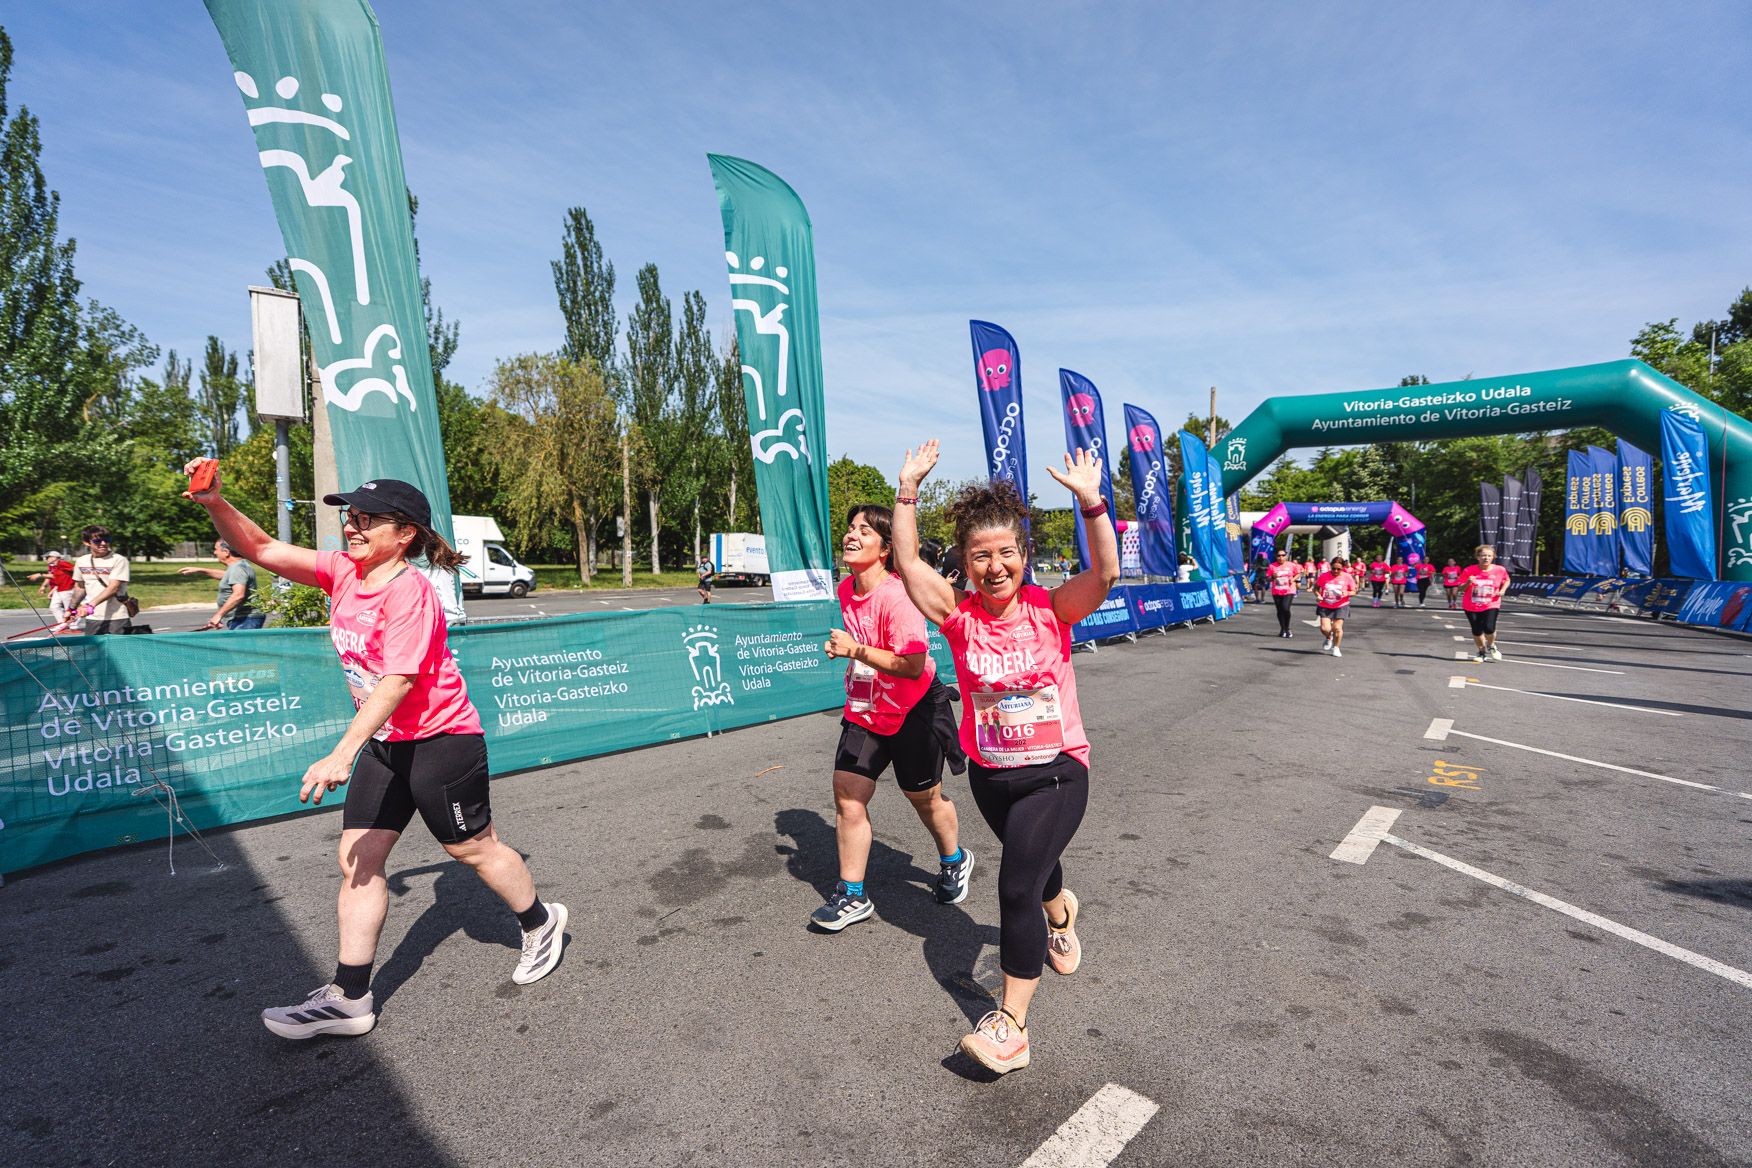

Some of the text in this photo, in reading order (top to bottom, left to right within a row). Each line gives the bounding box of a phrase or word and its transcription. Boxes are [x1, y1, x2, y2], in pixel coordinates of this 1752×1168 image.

[1343, 384, 1531, 413] Vitoria-Gasteizko Udala
[1311, 397, 1572, 432] Ayuntamiento de Vitoria-Gasteiz
[735, 631, 803, 648] Ayuntamiento
[736, 641, 819, 660] de Vitoria-Gasteiz
[491, 648, 602, 672] Ayuntamiento
[739, 656, 819, 676] Vitoria-Gasteizko
[491, 660, 629, 688] de Vitoria-Gasteiz
[742, 676, 771, 690] Udala
[38, 677, 254, 715] Ayuntamiento
[494, 680, 628, 709] Vitoria-Gasteizko
[40, 692, 302, 739] de Vitoria-Gasteiz
[498, 708, 547, 727] Udala
[1002, 723, 1035, 739] 016
[43, 720, 297, 770] Vitoria-Gasteizko
[47, 764, 141, 797] Udala
[452, 801, 465, 826] TERREX
